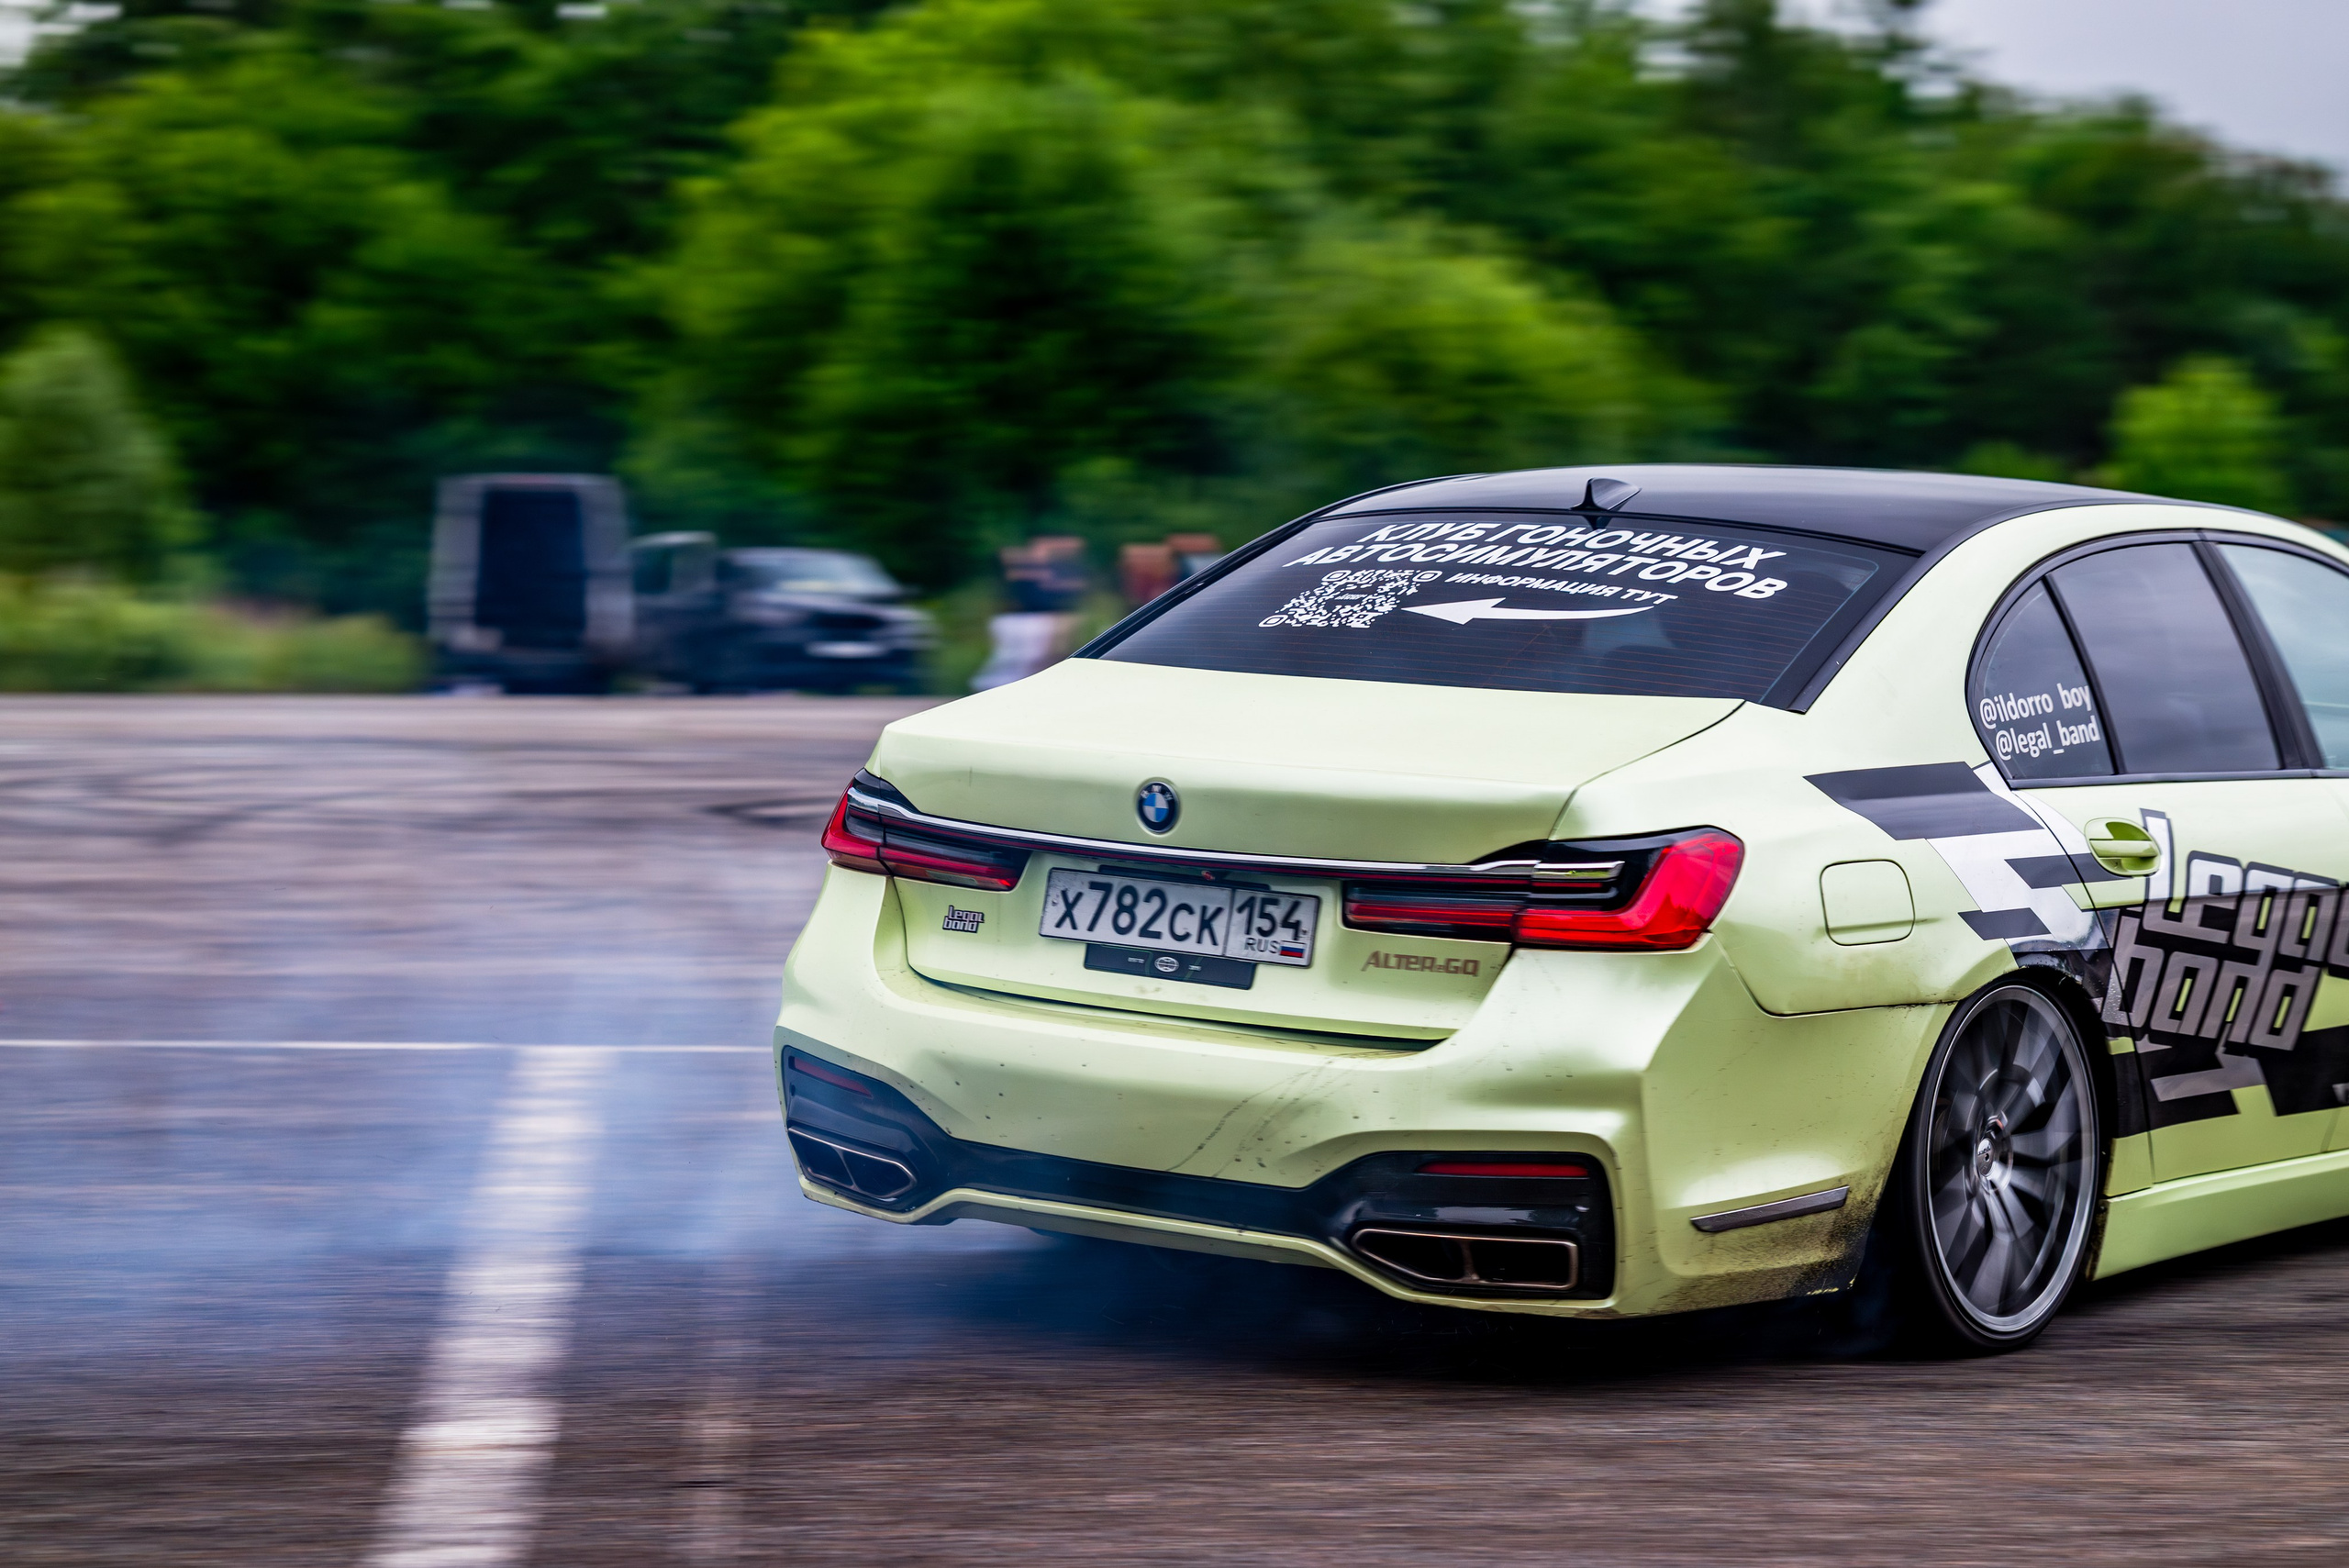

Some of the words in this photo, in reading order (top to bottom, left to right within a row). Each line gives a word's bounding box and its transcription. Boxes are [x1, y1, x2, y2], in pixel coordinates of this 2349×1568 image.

[1355, 523, 1502, 543] КЛУБ
[1484, 523, 1787, 570] ГОНОЧНЫХ
[1282, 543, 1788, 599] АВТОСИМУЛЯТОРОВ
[1444, 572, 1623, 597] ИНФОРМАЦИЯ
[1620, 587, 1678, 606] ТУТ
[1979, 692, 2054, 730] @ildorro
[1995, 715, 2101, 762] @legal_band
[1236, 895, 1302, 941] 154
[1243, 937, 1281, 954] RUS
